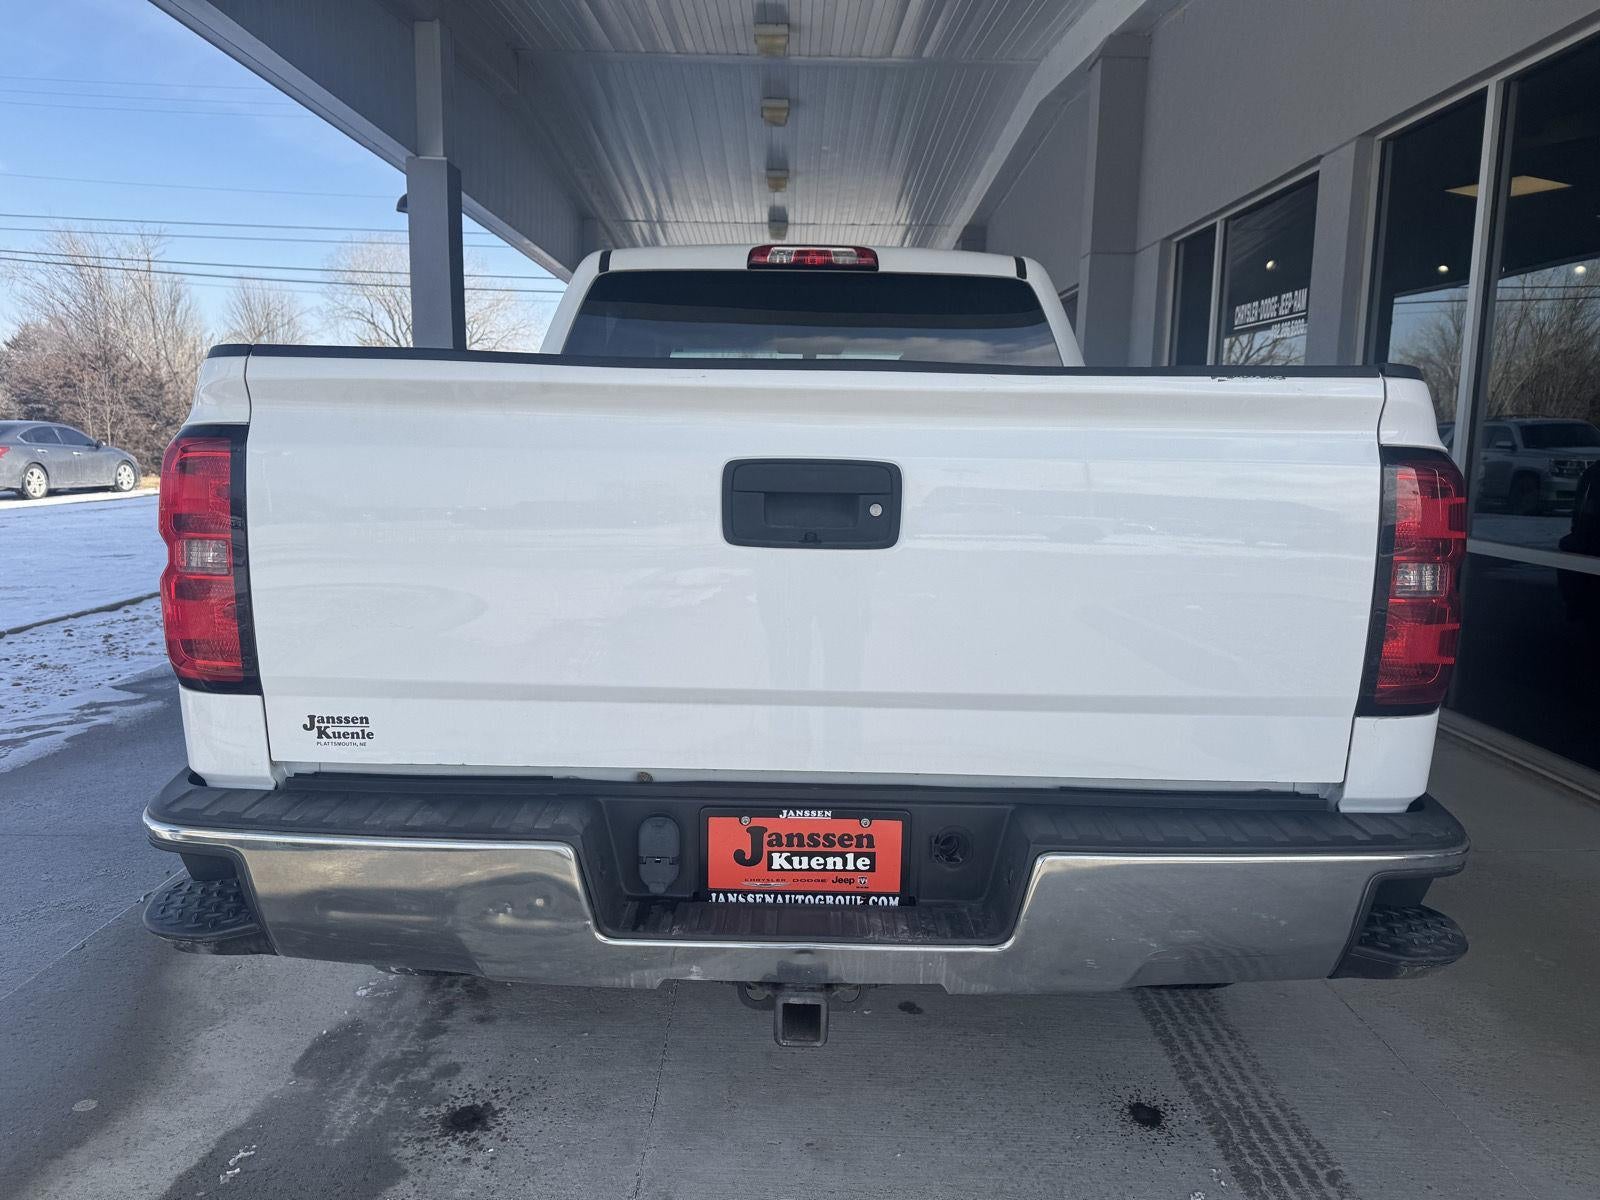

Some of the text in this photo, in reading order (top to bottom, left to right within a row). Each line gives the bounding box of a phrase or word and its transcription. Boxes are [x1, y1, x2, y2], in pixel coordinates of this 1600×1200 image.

[302, 714, 370, 731] Janssen
[316, 725, 375, 740] Kuenle
[779, 809, 832, 819] JANSSEN
[733, 825, 876, 867] Janssen
[771, 852, 872, 871] Kuenle
[831, 875, 855, 885] Jeep
[708, 892, 900, 906] JANSSENAUTOGROUPCOM
